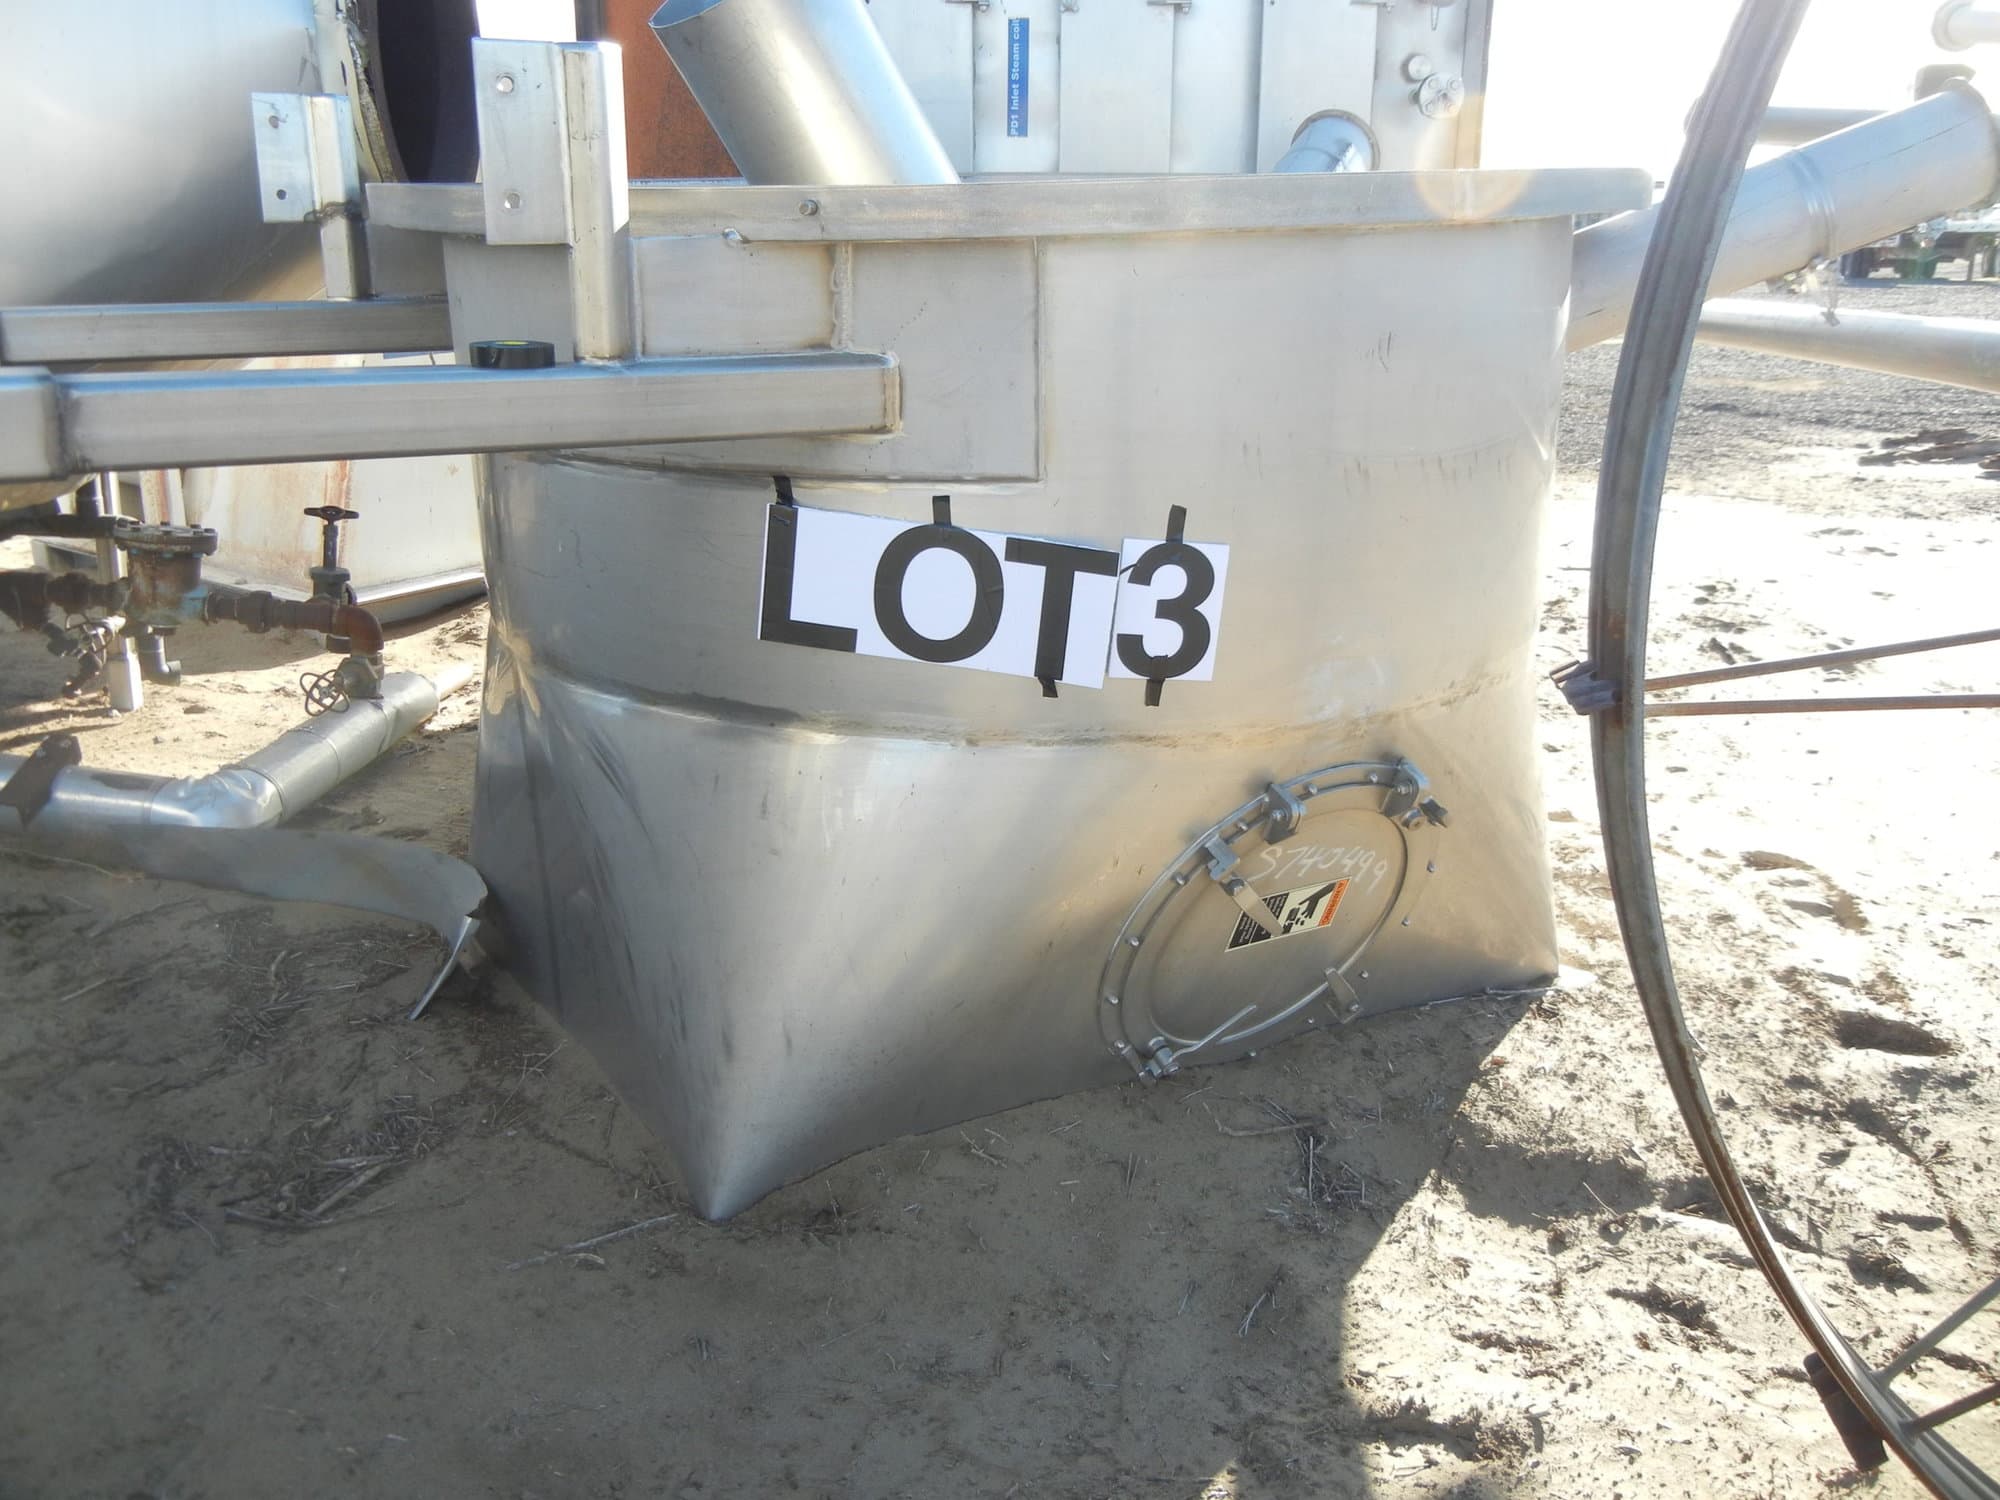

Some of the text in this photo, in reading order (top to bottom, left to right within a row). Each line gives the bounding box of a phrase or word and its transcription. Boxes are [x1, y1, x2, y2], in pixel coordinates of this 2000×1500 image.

[1010, 43, 1020, 81] Steam
[1010, 83, 1020, 110] Inlet
[760, 504, 1215, 680] LOT 3
